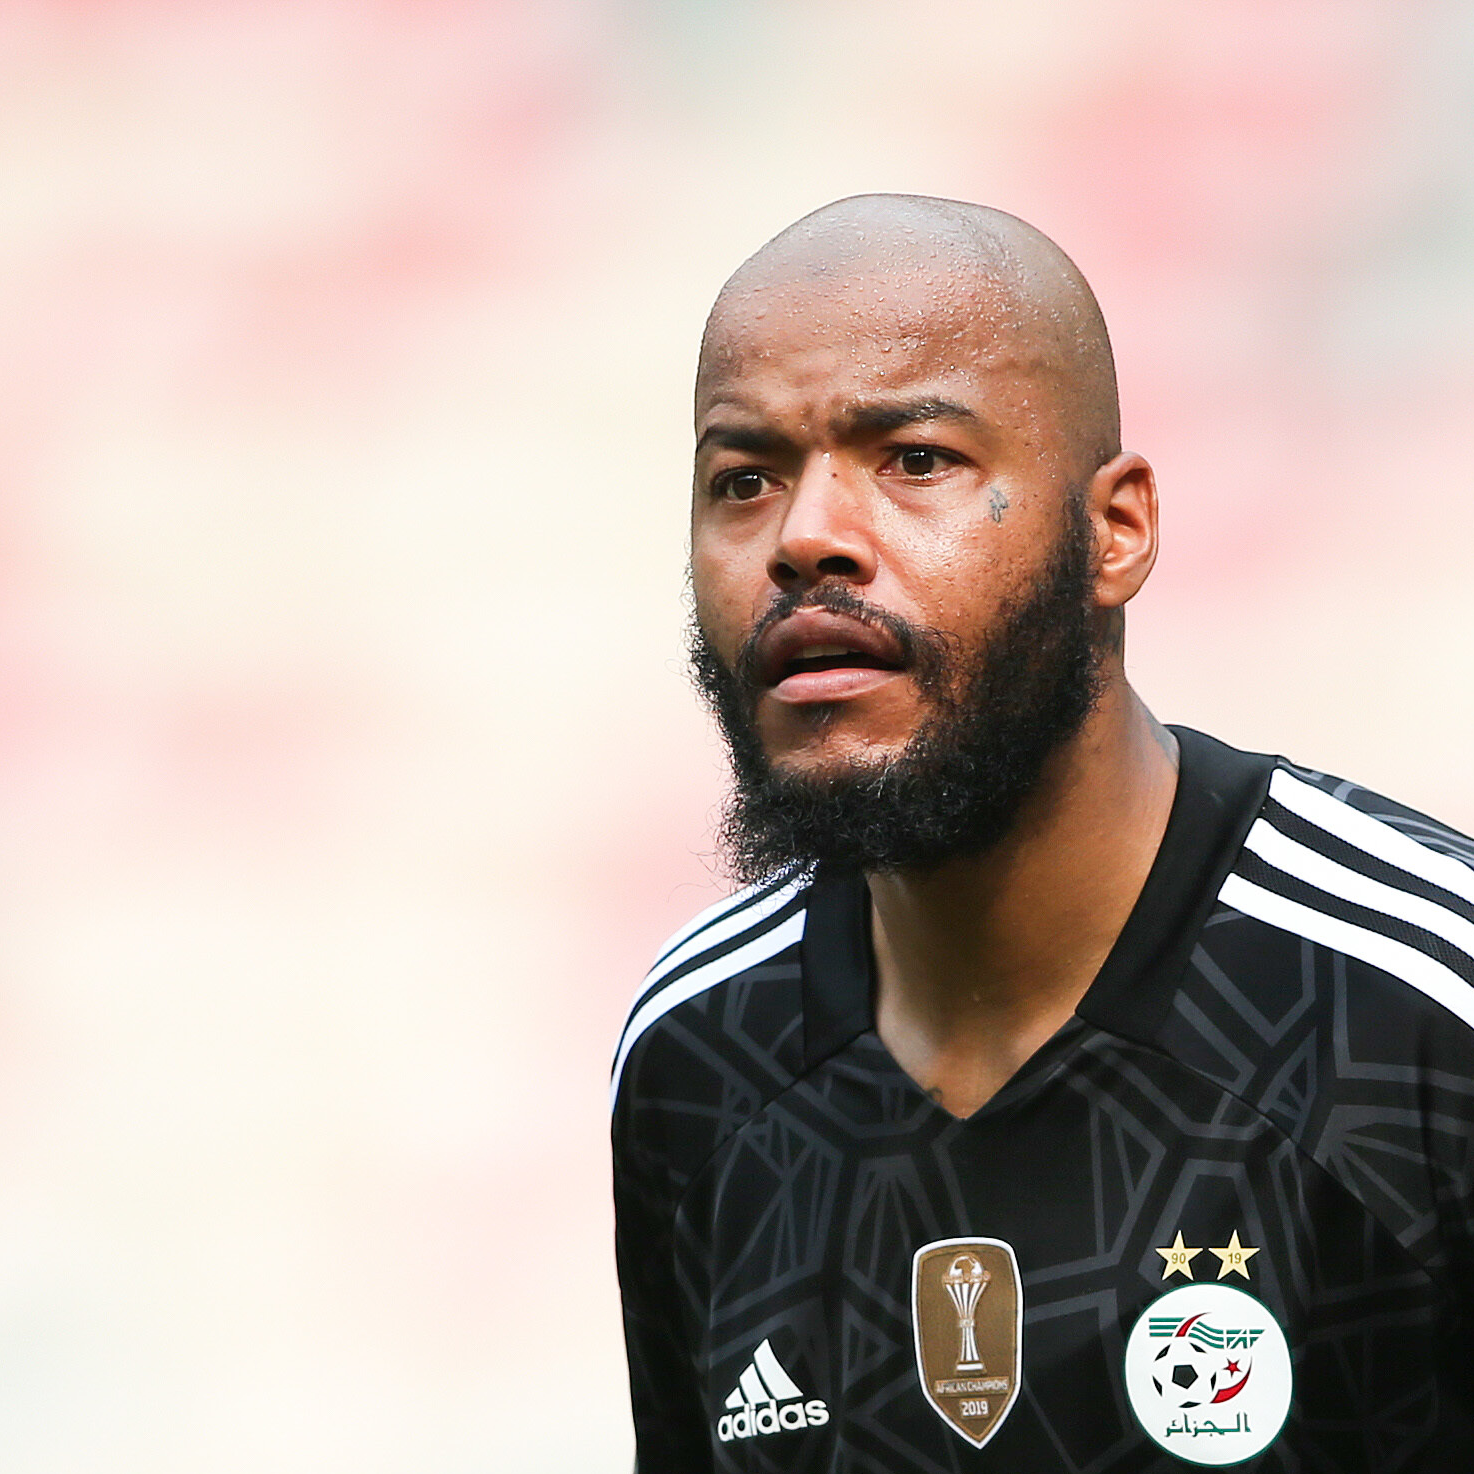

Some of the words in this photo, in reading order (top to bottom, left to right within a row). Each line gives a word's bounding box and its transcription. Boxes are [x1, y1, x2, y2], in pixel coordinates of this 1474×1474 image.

[1171, 1253, 1187, 1265] 90
[1228, 1252, 1242, 1264] 19
[961, 1400, 989, 1416] 2019
[717, 1399, 830, 1442] adidas
